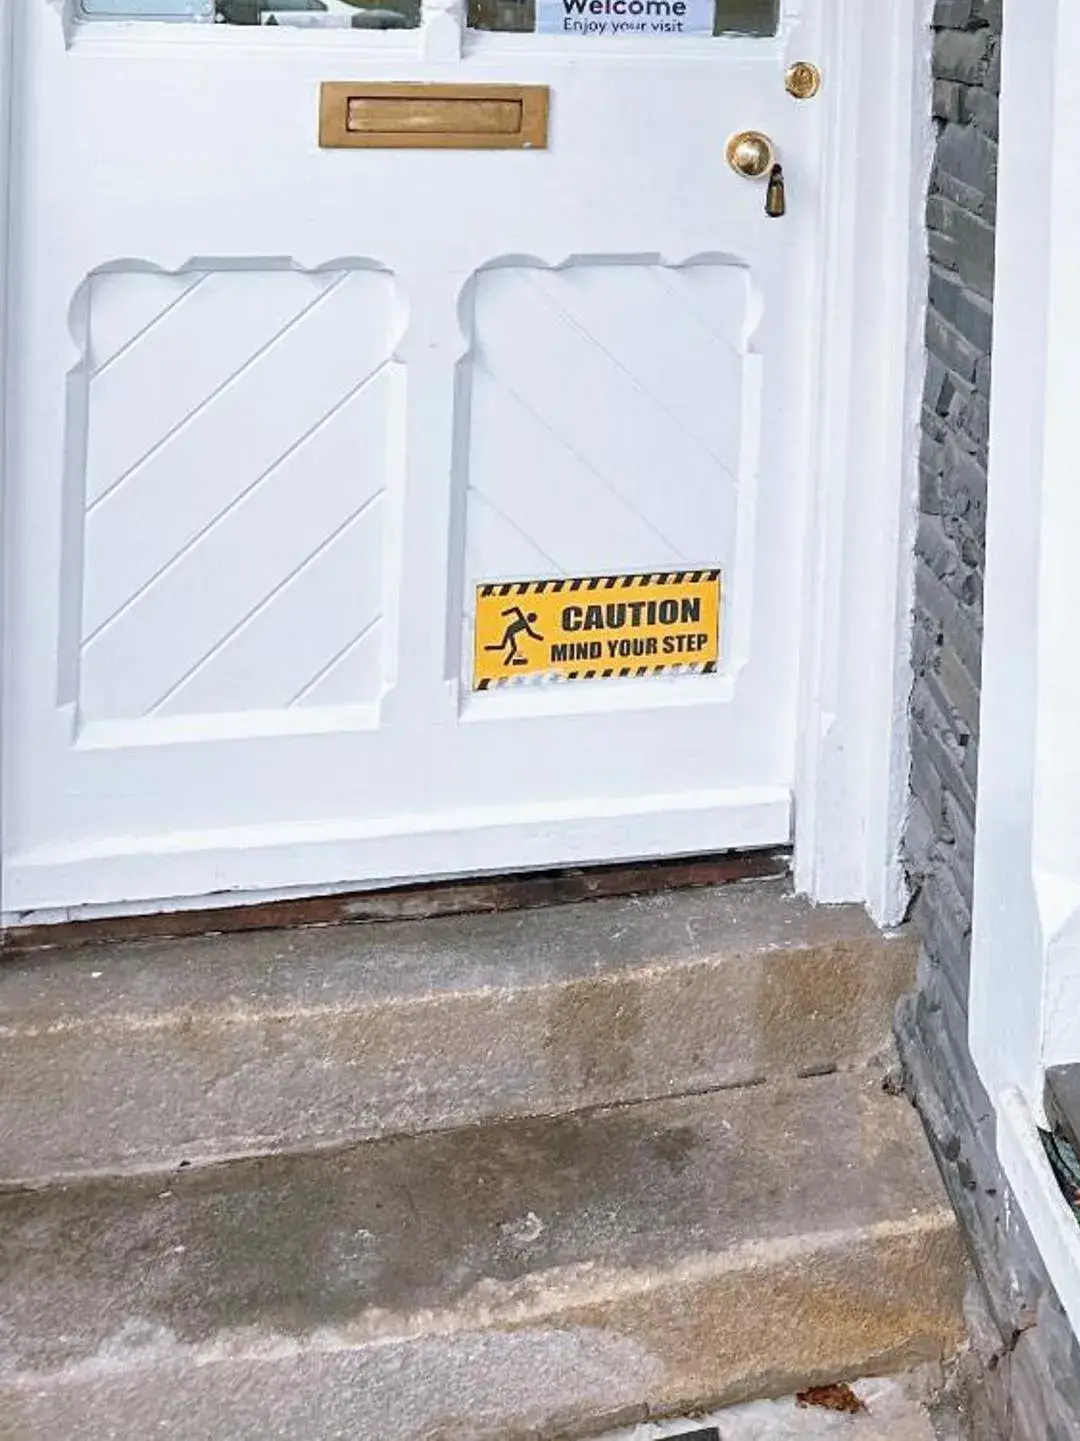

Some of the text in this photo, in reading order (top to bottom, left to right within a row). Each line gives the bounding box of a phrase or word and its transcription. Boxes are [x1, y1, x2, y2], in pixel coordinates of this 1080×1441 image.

[563, 17, 684, 35] Enjoy your visit
[562, 597, 701, 632] CAUTION
[551, 633, 708, 662] MIND YOUR STEP
